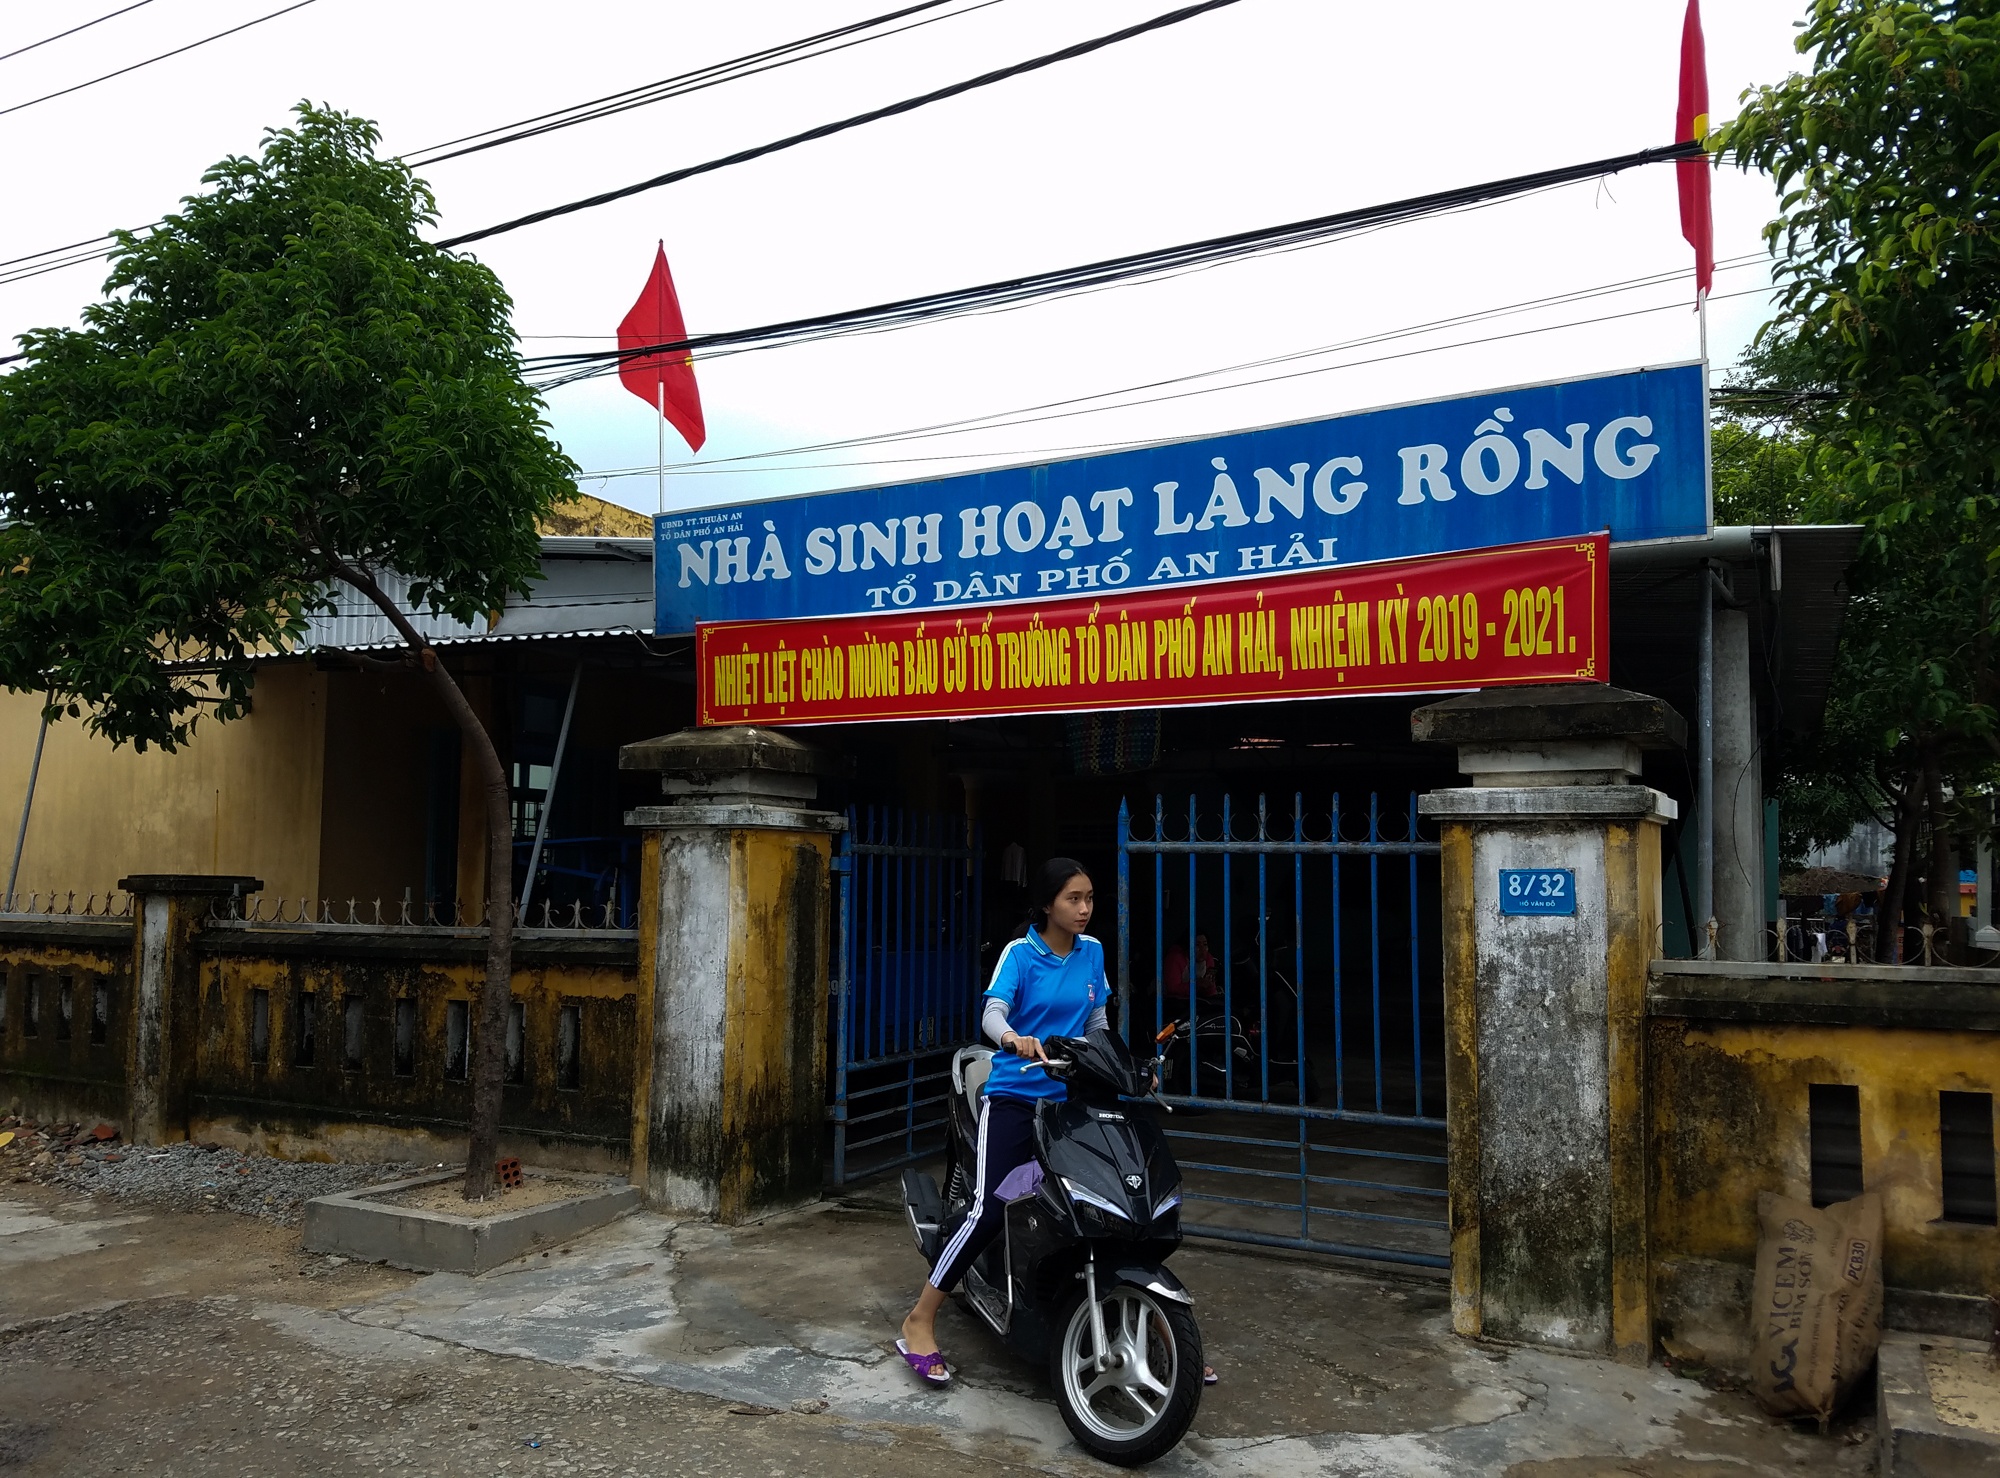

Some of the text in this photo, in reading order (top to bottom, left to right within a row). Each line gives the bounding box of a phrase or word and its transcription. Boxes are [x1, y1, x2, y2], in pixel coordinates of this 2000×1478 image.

[661, 520, 683, 529] UBND
[730, 512, 743, 521] AN
[677, 407, 1661, 589] NHÀ SINH HOẠT LÀNG RỒNG
[674, 530, 691, 539] DÂN
[693, 525, 710, 536] PHỐ
[713, 526, 725, 534] AN
[865, 532, 1338, 609] TỔ DÂN PHỐ AN HẢI
[714, 642, 760, 718] NHIỆT
[763, 639, 797, 715] LIỆT
[801, 635, 844, 702] CHÀO
[847, 631, 899, 699] MỪNG
[903, 621, 939, 695] BẦU
[943, 618, 968, 693] CỬ
[969, 611, 994, 691] TỔ
[996, 612, 1071, 690] TRƯỞNG
[1075, 601, 1100, 685] TỔ
[1105, 609, 1148, 683] DÂN
[1153, 597, 1197, 680] PHỐ
[1202, 613, 1233, 677] AN
[1238, 590, 1284, 681] HẢI,
[1290, 589, 1371, 683] NHIỆM
[1377, 583, 1410, 665] KỲ
[1417, 592, 1480, 662] 2019
[1503, 585, 1576, 657] 2021.
[1509, 874, 1565, 896] 8/32
[1847, 1242, 1867, 1281] PCB30
[1768, 1247, 1798, 1339] VICEM
